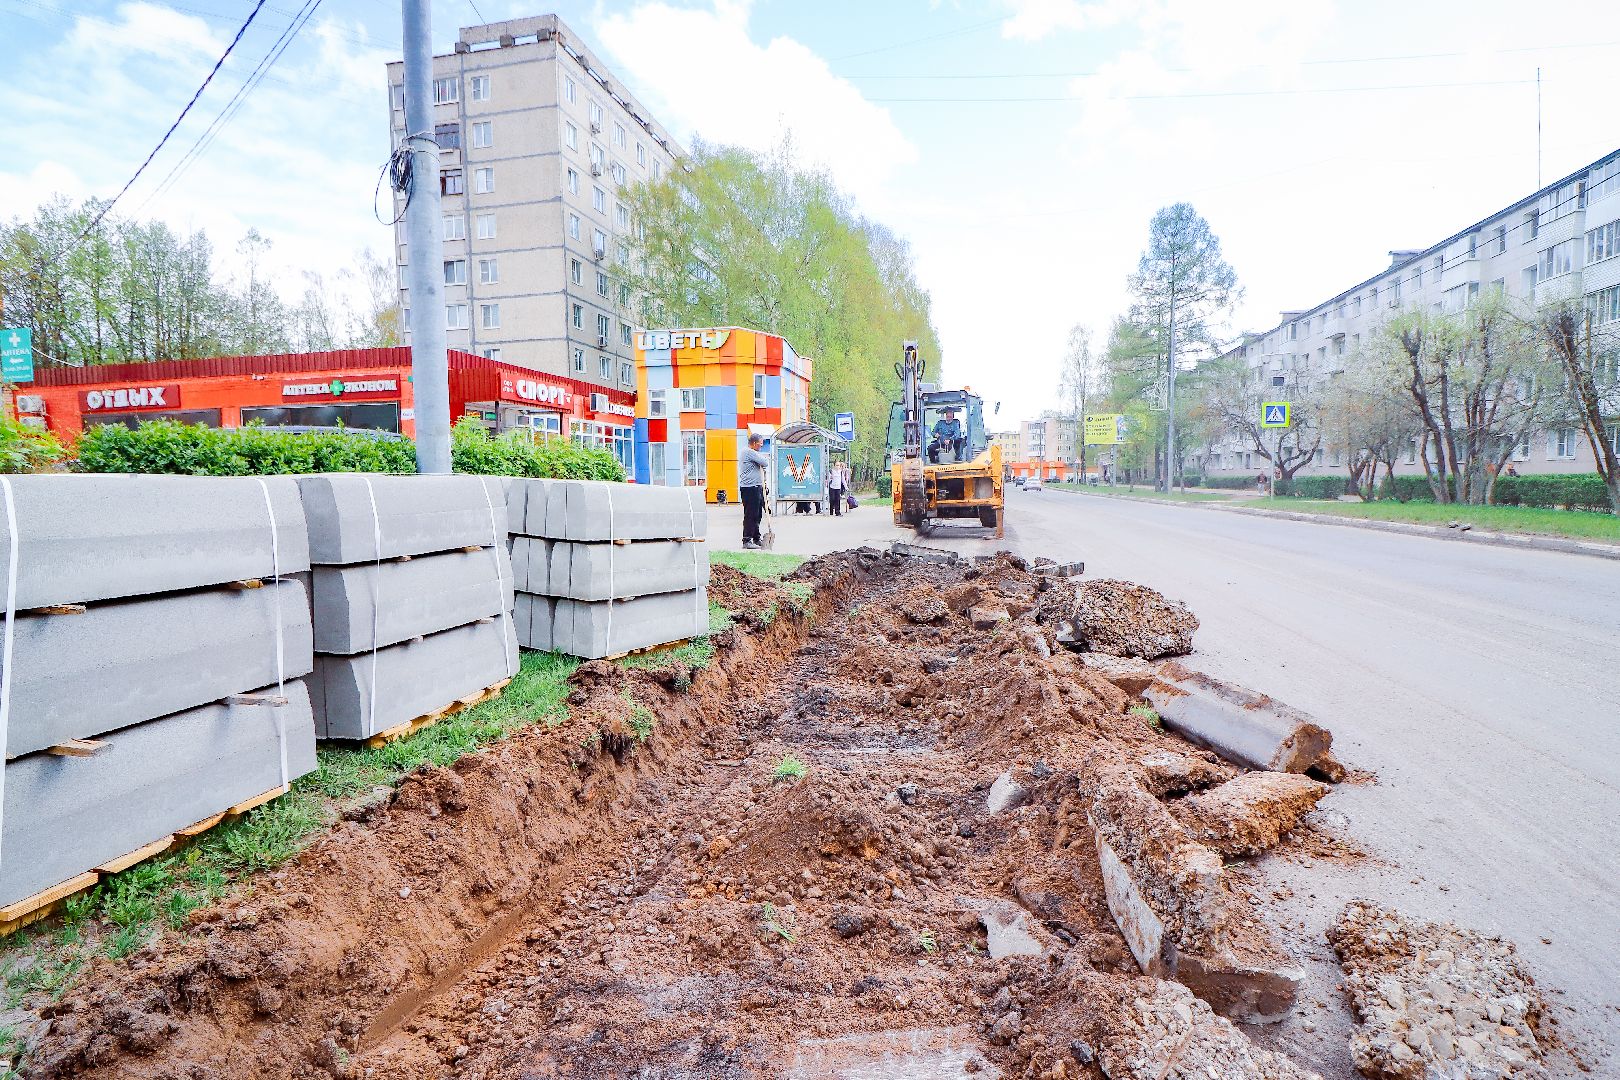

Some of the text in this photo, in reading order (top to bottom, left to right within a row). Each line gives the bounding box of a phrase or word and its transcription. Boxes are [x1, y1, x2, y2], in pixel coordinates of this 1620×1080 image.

[638, 332, 730, 350] ЦВЕТЫ
[87, 387, 166, 409] ОТДЫХ
[282, 380, 397, 396] АПТЕКА ЭКОНОМ
[516, 380, 565, 405] СПОРТ
